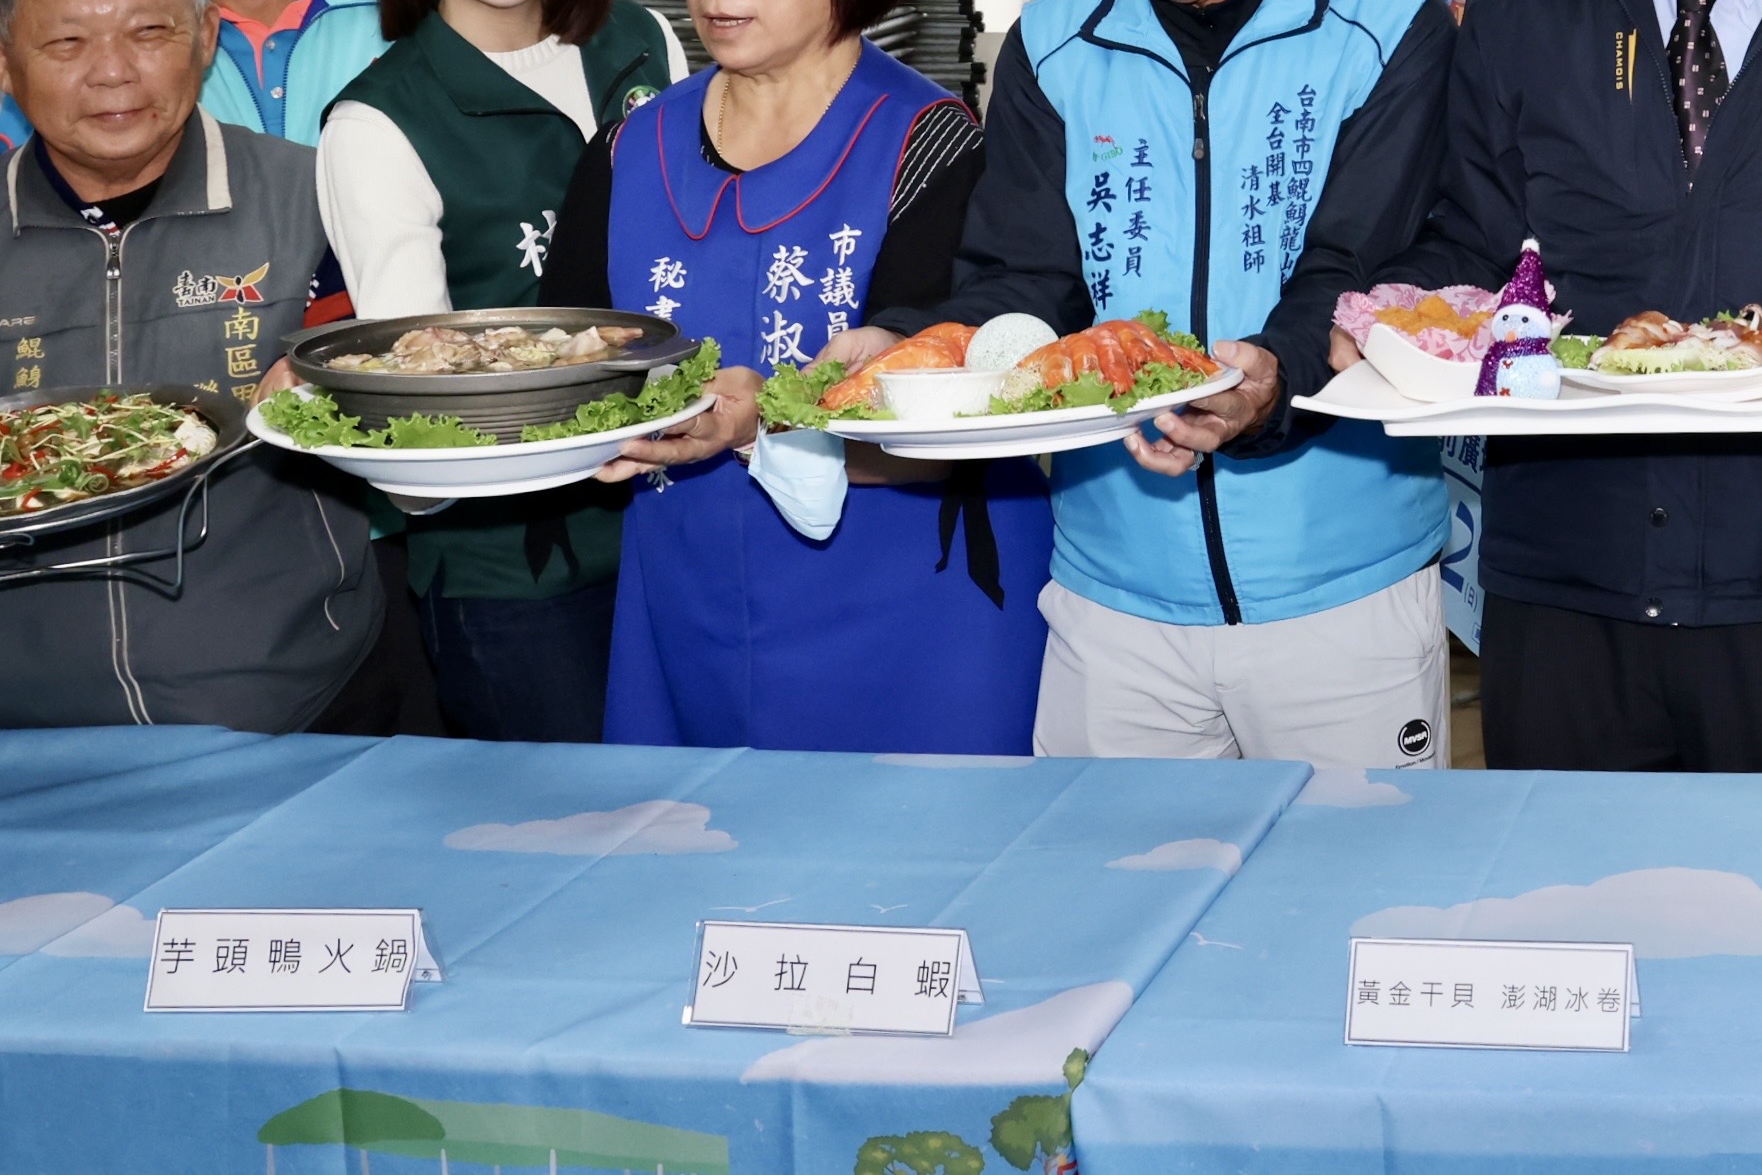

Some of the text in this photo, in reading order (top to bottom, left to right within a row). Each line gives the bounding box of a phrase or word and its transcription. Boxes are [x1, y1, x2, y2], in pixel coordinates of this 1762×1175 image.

[1615, 31, 1624, 90] CHAMOIS
[1265, 102, 1292, 207] 全台開基
[1278, 84, 1317, 290] 台南市四鯤鯓龍山
[1085, 172, 1118, 311] 吳志祥
[1122, 138, 1154, 278] 主任委員
[1241, 164, 1266, 274] 清水祖師
[176, 294, 216, 307] TAINAN
[160, 937, 408, 974] 芋頭鴨火鍋
[702, 950, 951, 998] 沙拉白蝦
[1357, 979, 1621, 1013] 黃金干貝 澎湖冰卷
